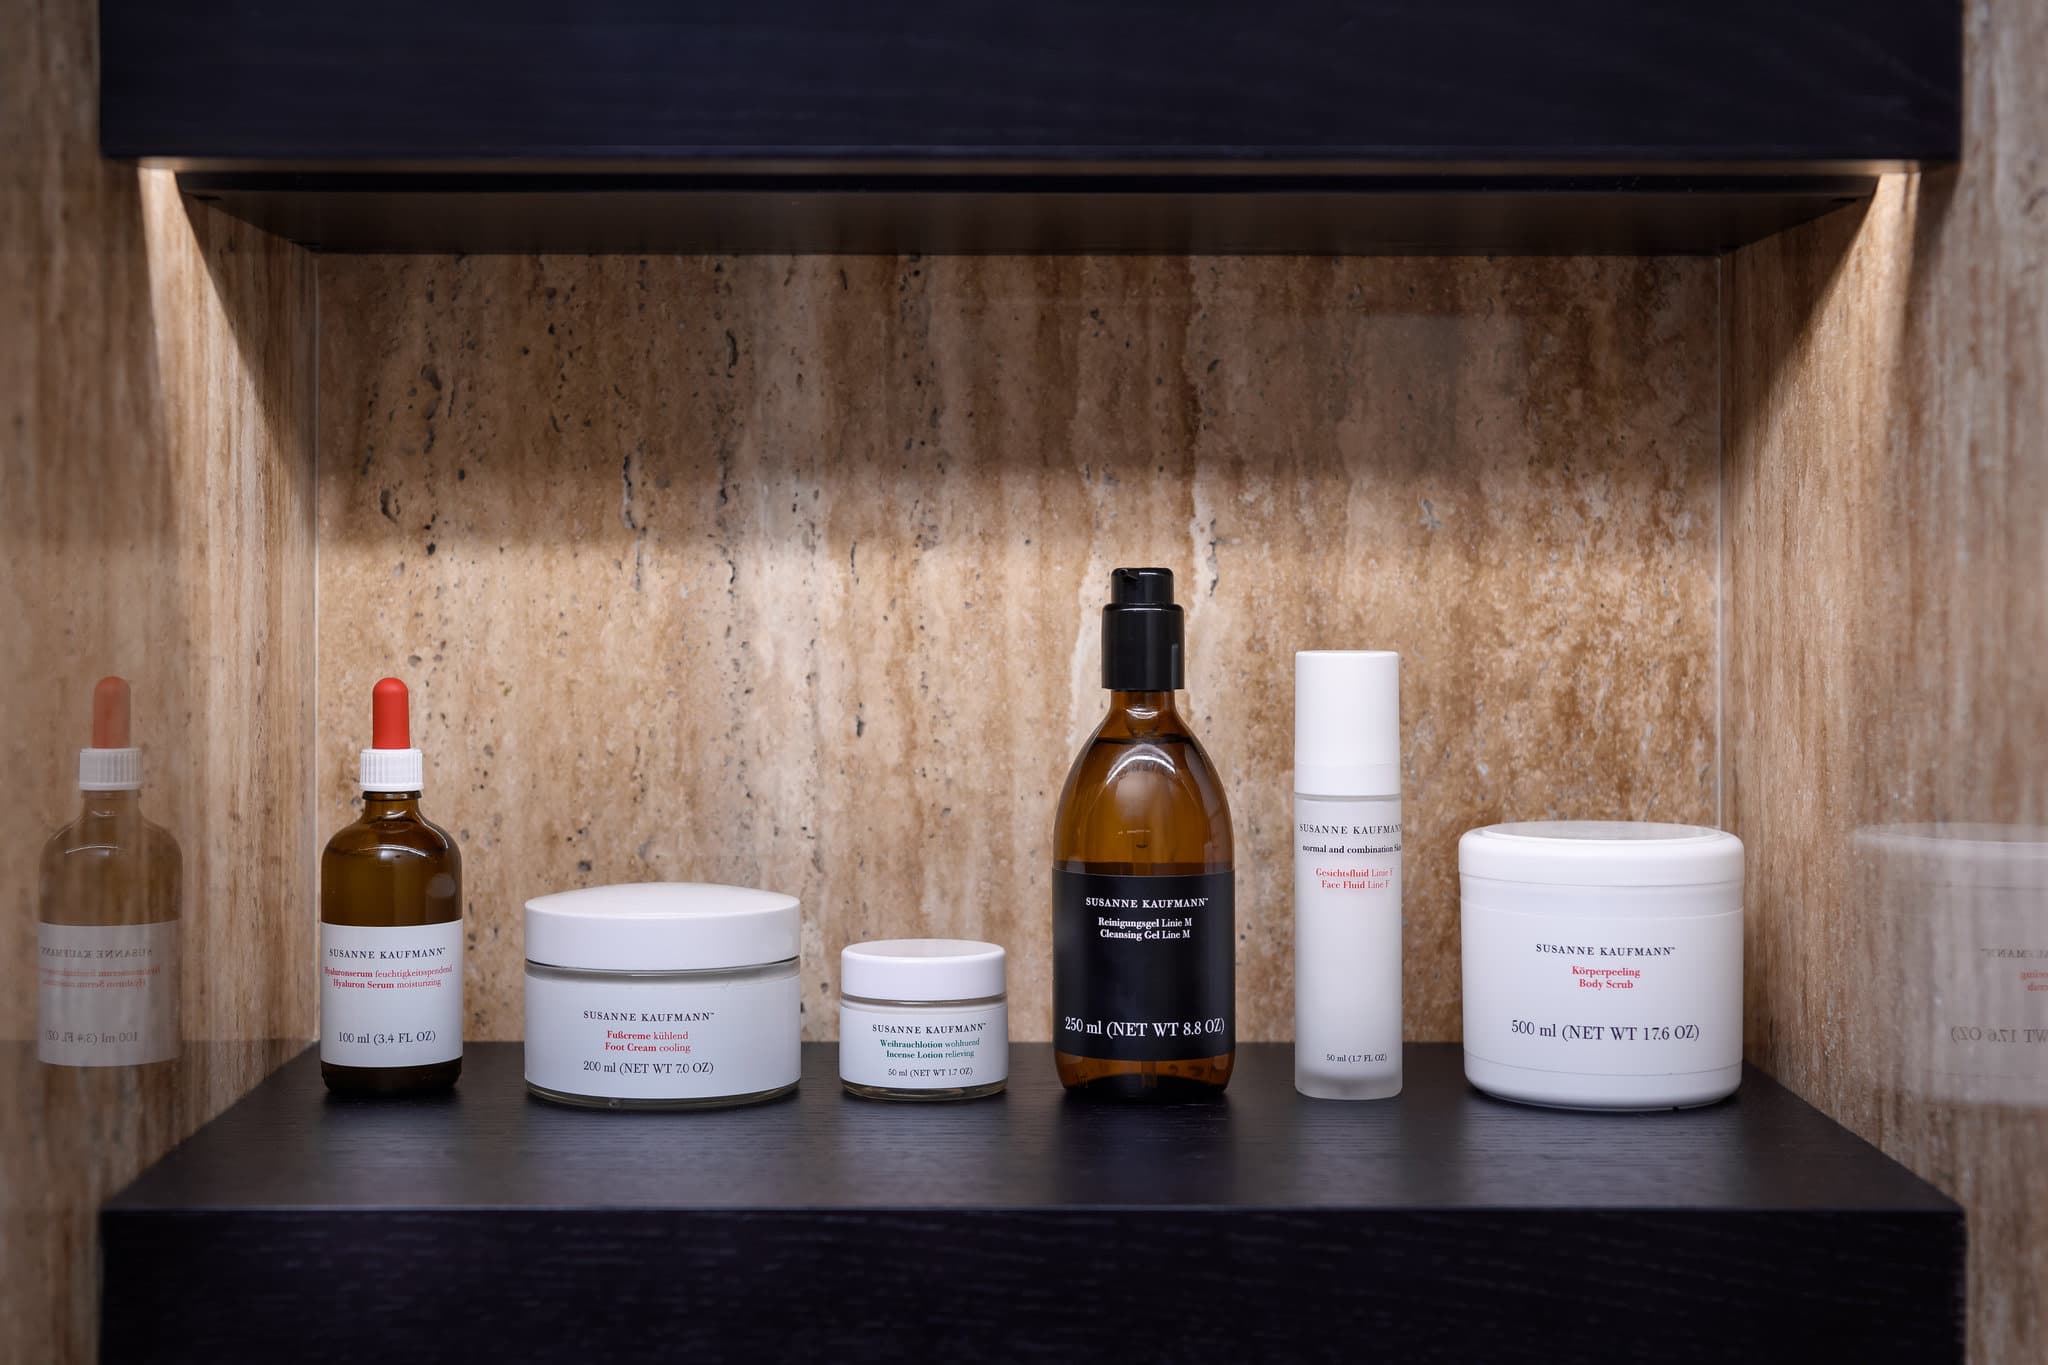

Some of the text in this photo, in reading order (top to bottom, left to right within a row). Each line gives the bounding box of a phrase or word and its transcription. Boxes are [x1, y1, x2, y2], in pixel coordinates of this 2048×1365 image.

[1300, 824, 1348, 834] SUSANNE
[1302, 845, 1326, 853] normal
[1347, 845, 1393, 853] combination
[1316, 868, 1369, 877] Gesichtsfluid
[1322, 880, 1340, 888] Face
[1343, 880, 1365, 888] Fluid
[1368, 880, 1384, 888] Line
[1086, 897, 1138, 908] SUSANNE
[1098, 917, 1192, 929] Reinigungsgel Linie M
[1100, 929, 1190, 941] Cleansing Gel Line M
[329, 948, 375, 959] SUSANNE
[1536, 944, 1594, 956] SUSANNE
[1572, 966, 1640, 978] Körperpeeling
[333, 979, 442, 989] Hyaluron Serum moisturizing
[1579, 979, 1633, 991] Body Scrub
[583, 1010, 636, 1021] SUSANNE
[872, 1024, 921, 1034] SUSANNE
[1065, 1016, 1225, 1039] 250 ml (NET WT 8.8 OZ)
[1512, 1020, 1700, 1042] 500 ml (NET WT 17.6 OZ)
[338, 1030, 436, 1045] 100 ml (3.4 FL OZ)
[607, 1030, 688, 1040] Fußcreme kühlend
[605, 1042, 691, 1054] Foot Cream cooling
[880, 1037, 980, 1048] Weihrauchlotion wohltuend
[887, 1050, 974, 1059] Incense Lotion relieving
[1337, 1054, 1346, 1062] ml
[1375, 1053, 1387, 1063] OZ)
[583, 1060, 601, 1071] 200
[604, 1062, 616, 1073] ml
[620, 1062, 649, 1075] (NET
[653, 1063, 673, 1074] WT
[693, 1062, 714, 1074] OZ)
[888, 1068, 896, 1076] 50
[899, 1069, 908, 1077] ml
[910, 1069, 930, 1078] (NET
[933, 1069, 946, 1077] WT
[960, 1067, 973, 1076] OZ)
